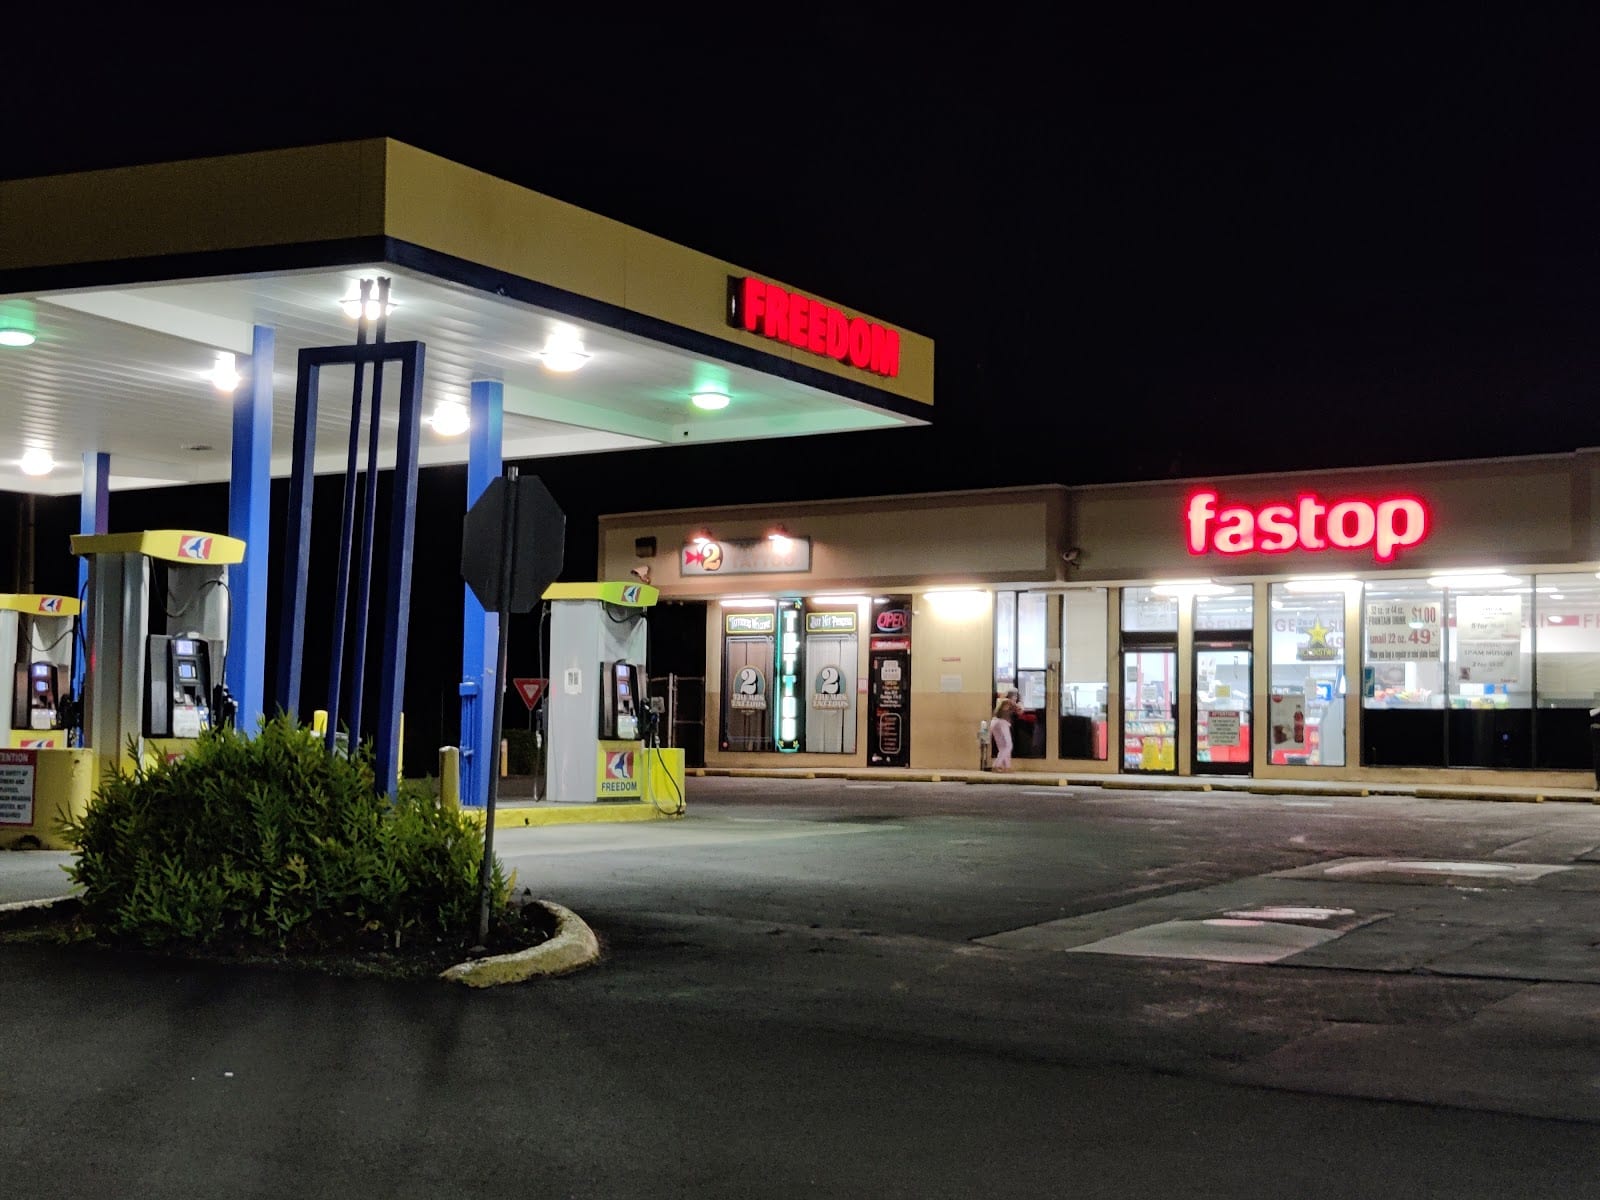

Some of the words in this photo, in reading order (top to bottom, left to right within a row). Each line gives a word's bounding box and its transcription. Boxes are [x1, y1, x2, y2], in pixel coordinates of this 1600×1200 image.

[744, 276, 899, 377] FREEDOM
[1186, 492, 1426, 560] fastop
[878, 612, 907, 628] OPEN
[741, 668, 758, 695] 2
[822, 667, 839, 694] 2
[601, 781, 638, 792] FREEDOM
